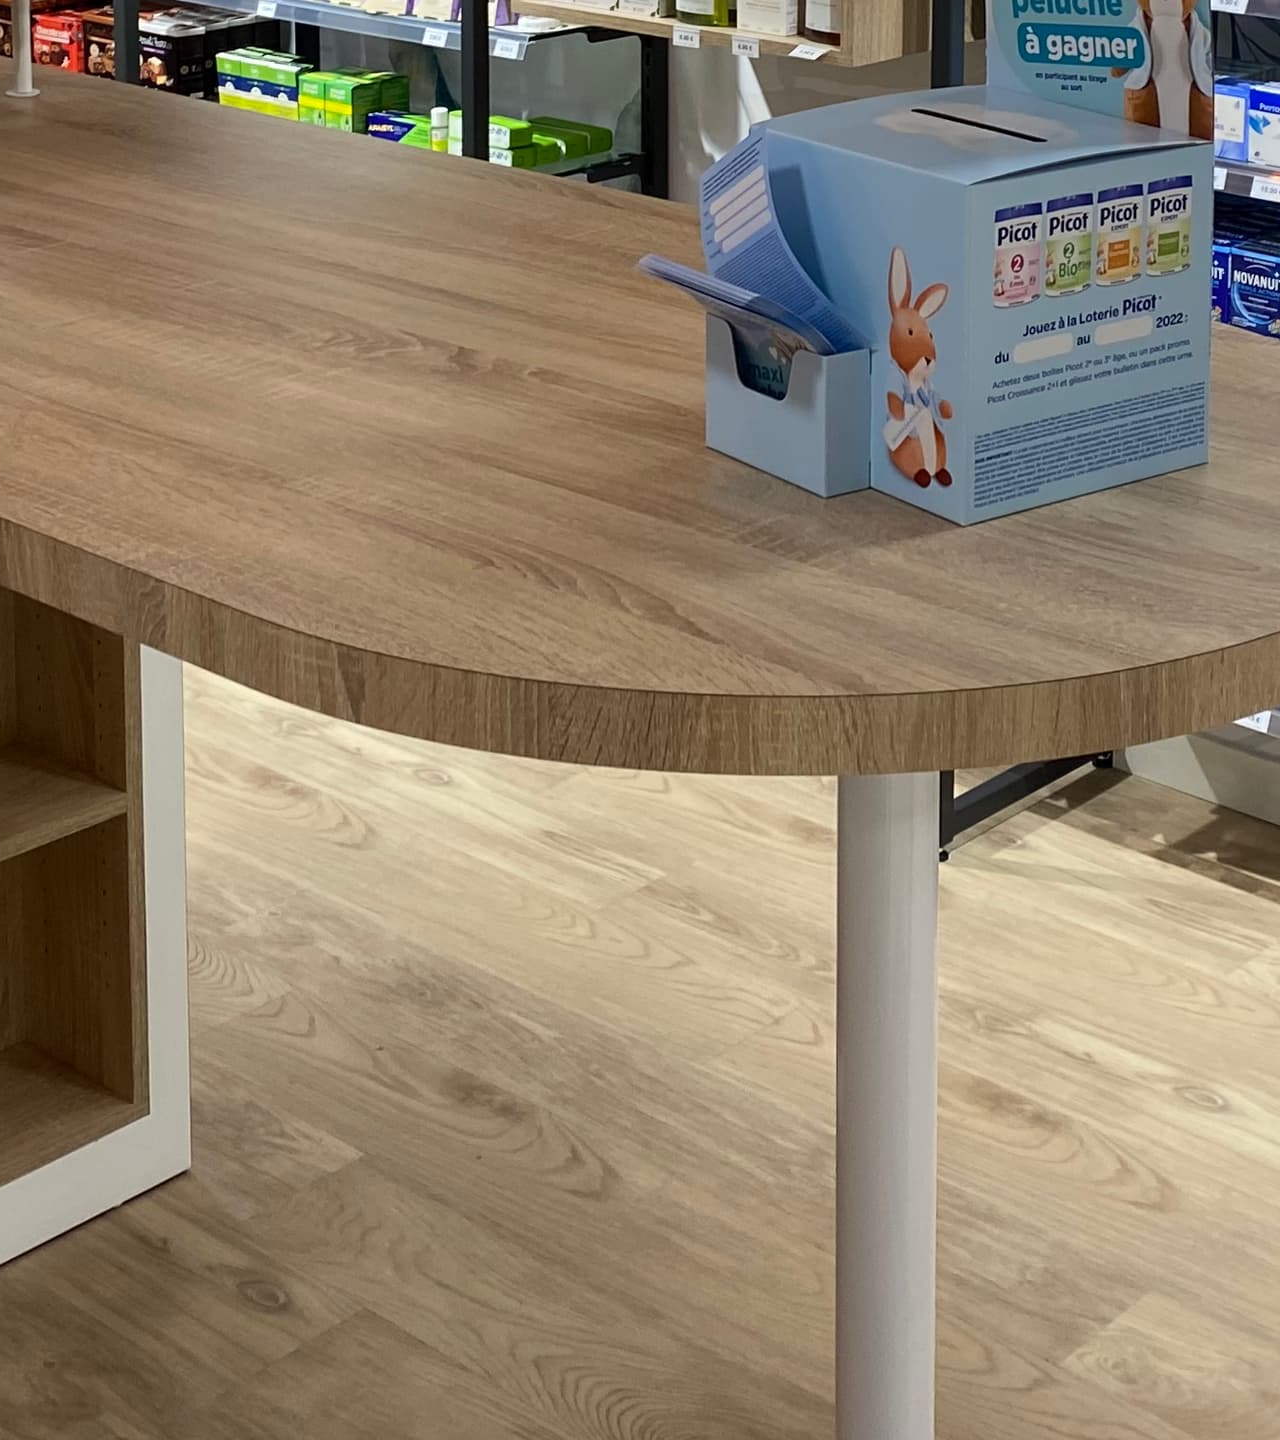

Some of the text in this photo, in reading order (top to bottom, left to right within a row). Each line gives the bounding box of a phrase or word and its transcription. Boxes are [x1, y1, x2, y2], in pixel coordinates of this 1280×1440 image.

[1026, 26, 1136, 62] à gagner
[1100, 203, 1138, 226] Picot
[1150, 194, 1188, 216] Picot
[998, 222, 1038, 246] Picot
[1049, 212, 1088, 236] Picot
[1013, 256, 1022, 268] 2
[1023, 319, 1056, 337] Jouez
[1058, 317, 1065, 328] à
[1067, 315, 1077, 327] la
[1079, 306, 1119, 325] Loterie
[994, 352, 1009, 364] du
[1076, 335, 1091, 346] au
